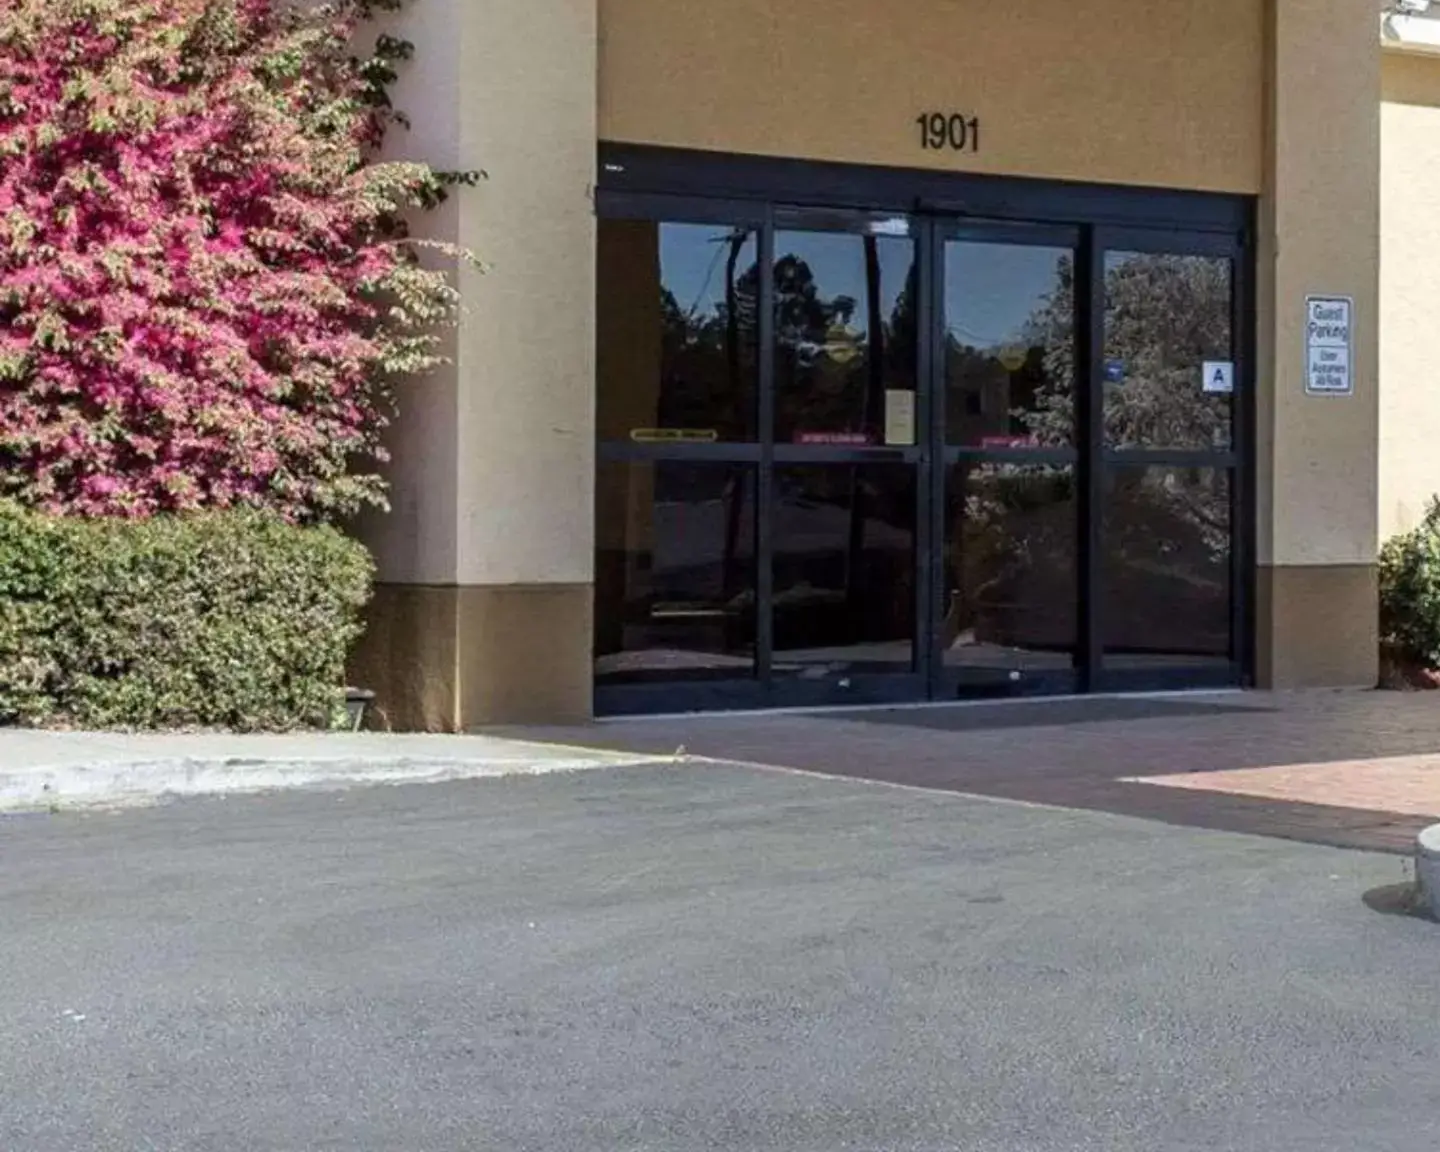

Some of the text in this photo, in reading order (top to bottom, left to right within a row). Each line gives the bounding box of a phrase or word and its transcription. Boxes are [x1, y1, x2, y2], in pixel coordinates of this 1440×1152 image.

[916, 112, 979, 152] 1901
[1313, 304, 1344, 321] Guest
[1309, 322, 1347, 342] Parking
[1213, 368, 1224, 383] A
